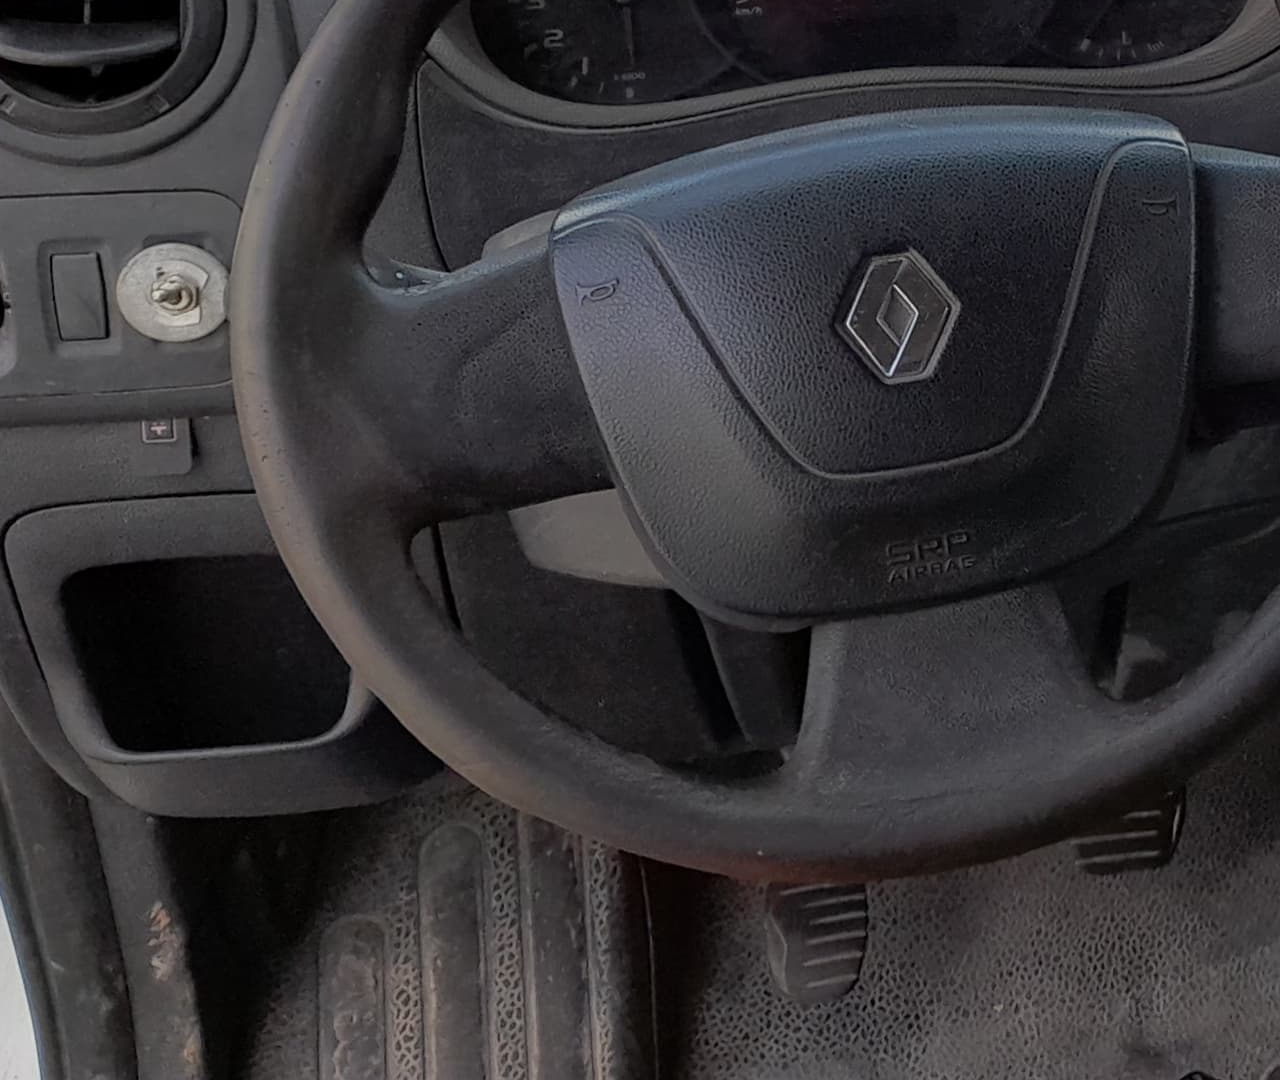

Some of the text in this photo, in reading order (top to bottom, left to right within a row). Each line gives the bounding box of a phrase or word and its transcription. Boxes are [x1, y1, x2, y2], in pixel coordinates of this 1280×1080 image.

[543, 29, 564, 48] 2
[581, 56, 589, 76] 1
[886, 529, 971, 566] SRP
